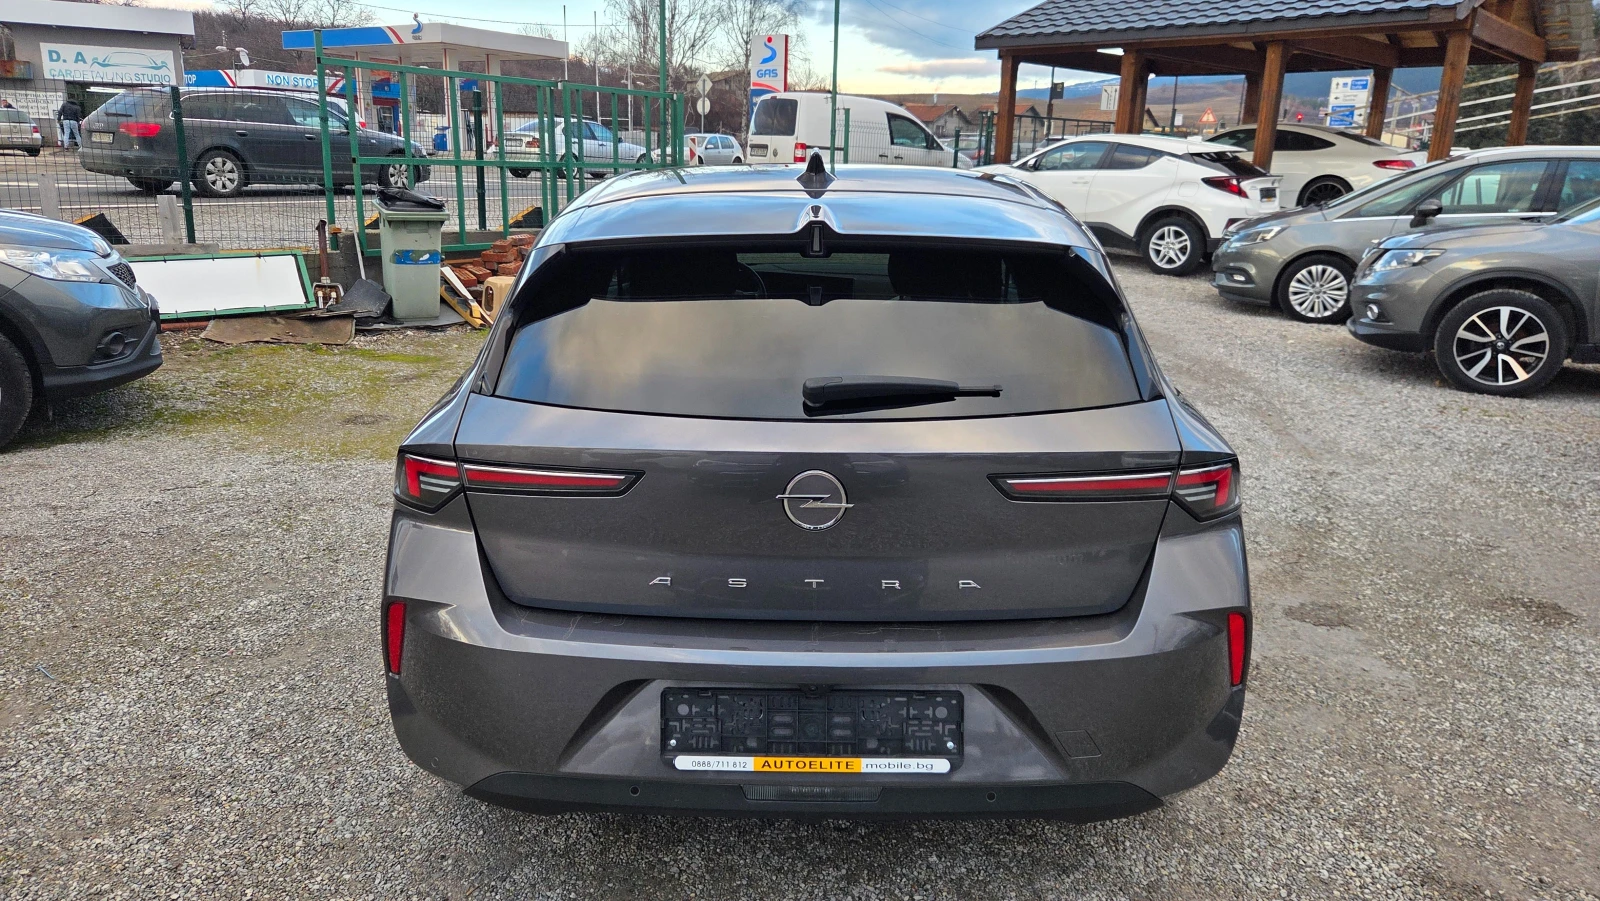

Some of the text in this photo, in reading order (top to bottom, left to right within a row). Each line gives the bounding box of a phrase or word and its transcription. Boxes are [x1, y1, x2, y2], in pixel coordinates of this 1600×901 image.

[134, 73, 171, 83] STUDIO
[756, 68, 779, 78] GAS
[184, 74, 197, 84] TOP
[266, 73, 319, 88] NON STOP
[649, 576, 981, 589] ASTRA
[691, 760, 730, 769] 0888/711
[732, 761, 748, 769] 812
[761, 760, 855, 770] AUTOELITE
